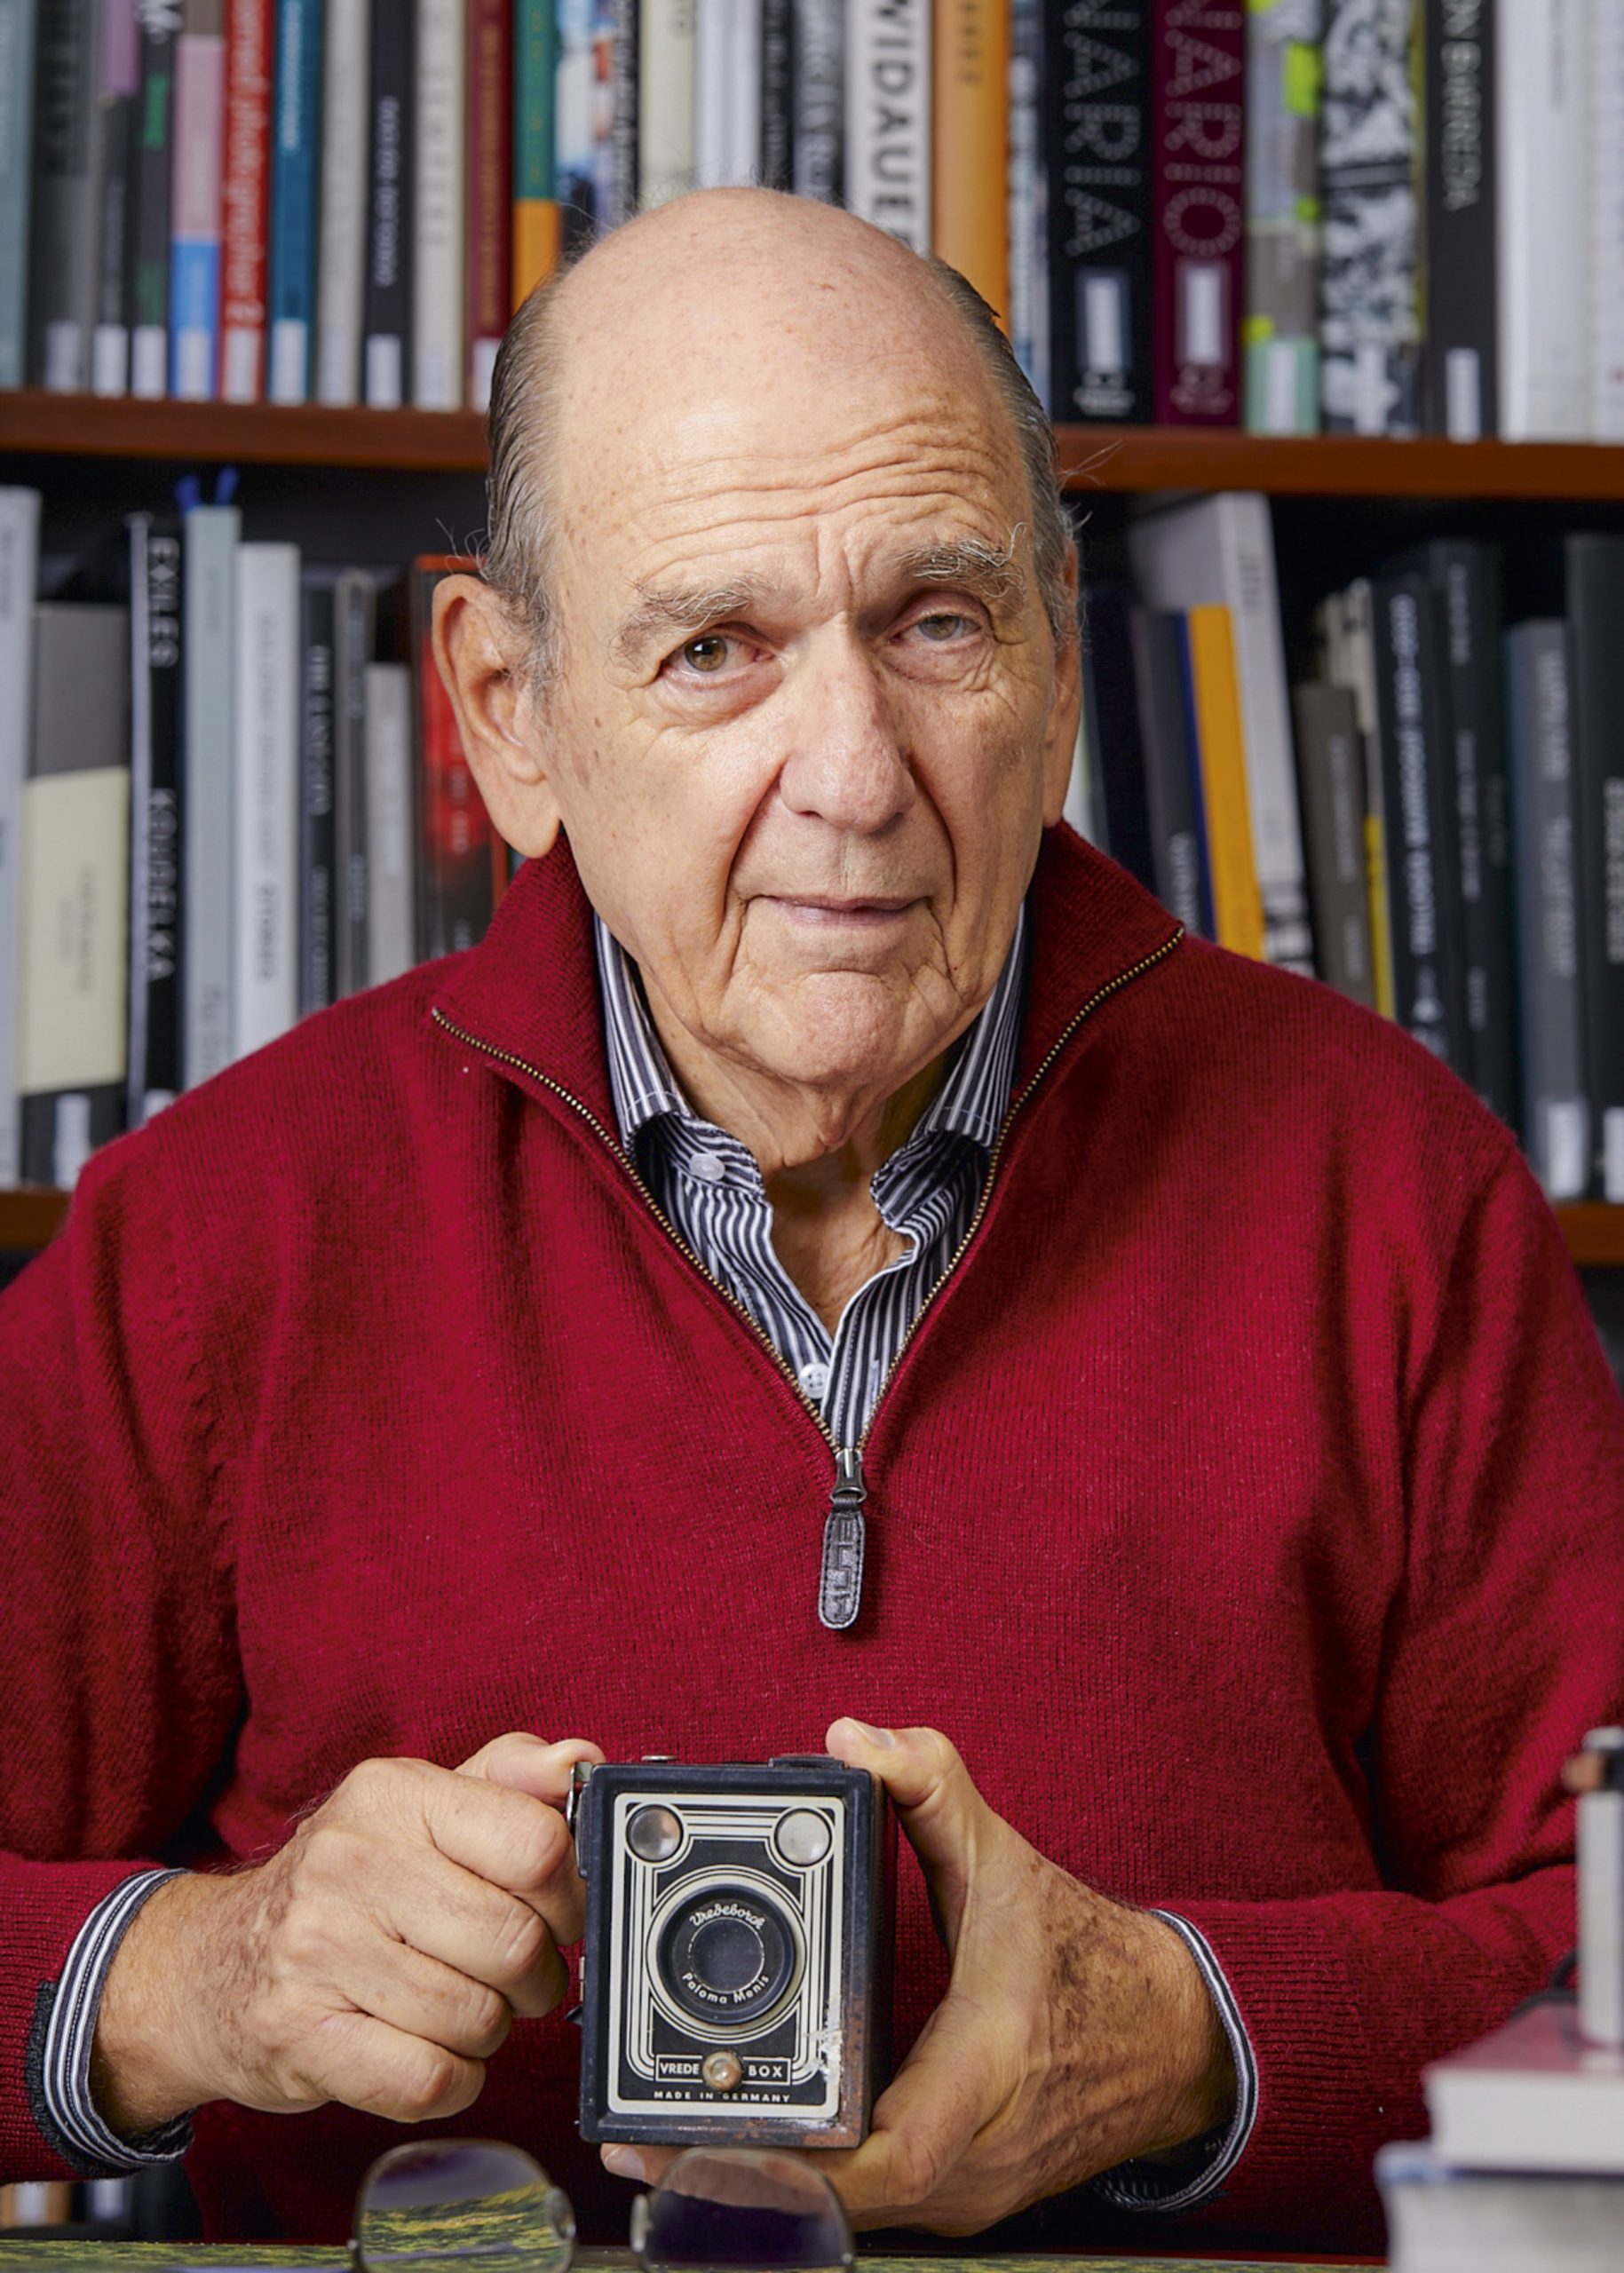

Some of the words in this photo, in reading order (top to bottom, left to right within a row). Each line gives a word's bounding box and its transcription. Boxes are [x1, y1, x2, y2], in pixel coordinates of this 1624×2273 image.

[872, 0, 915, 249] WIDAUE
[148, 536, 178, 668] EXILES
[148, 788, 178, 981] KOUDELKA
[682, 1971, 727, 2004] Paloma
[733, 1974, 770, 2003] Menis
[654, 2090, 691, 2100] MADE
[700, 2091, 714, 2100] IN
[722, 2092, 790, 2103] GERMANY
[660, 2063, 700, 2075] VREDE
[748, 2064, 783, 2078] BOX
